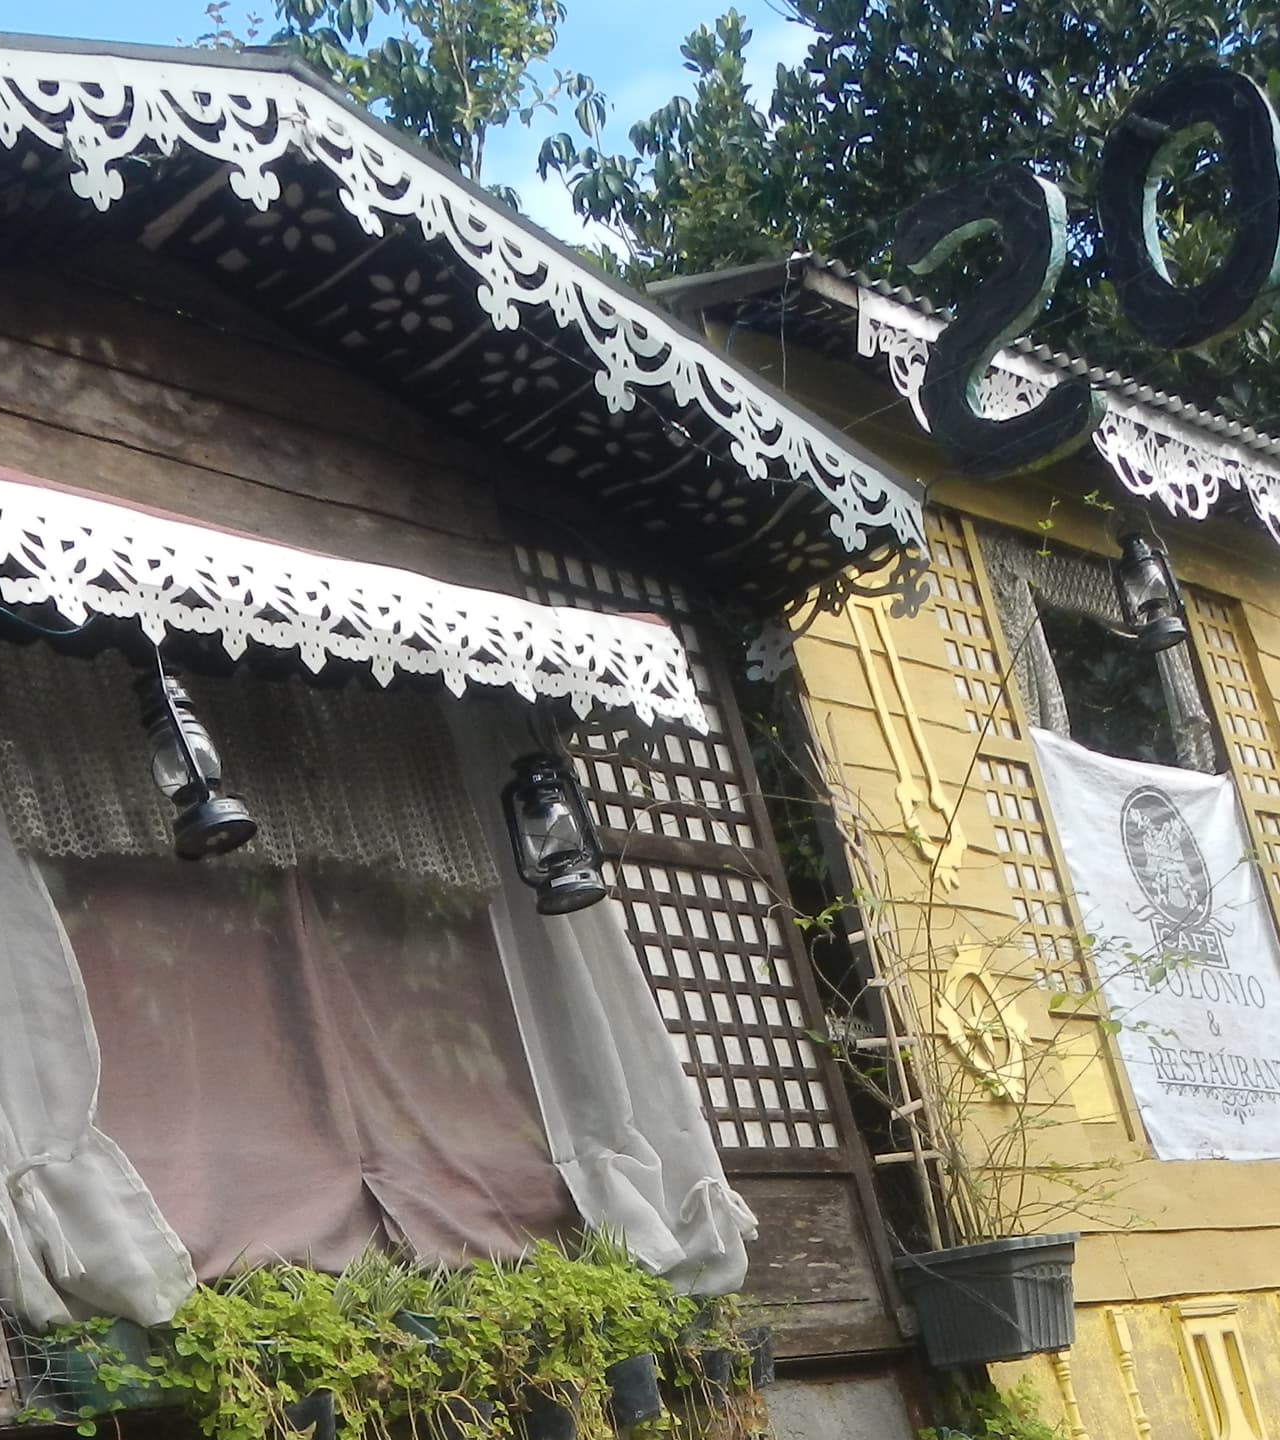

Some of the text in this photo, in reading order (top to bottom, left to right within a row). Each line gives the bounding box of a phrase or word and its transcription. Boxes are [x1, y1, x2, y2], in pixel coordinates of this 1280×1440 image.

[1158, 928, 1220, 956] CAFE
[1132, 960, 1266, 1009] AOLONIO
[1206, 1009, 1221, 1037] &
